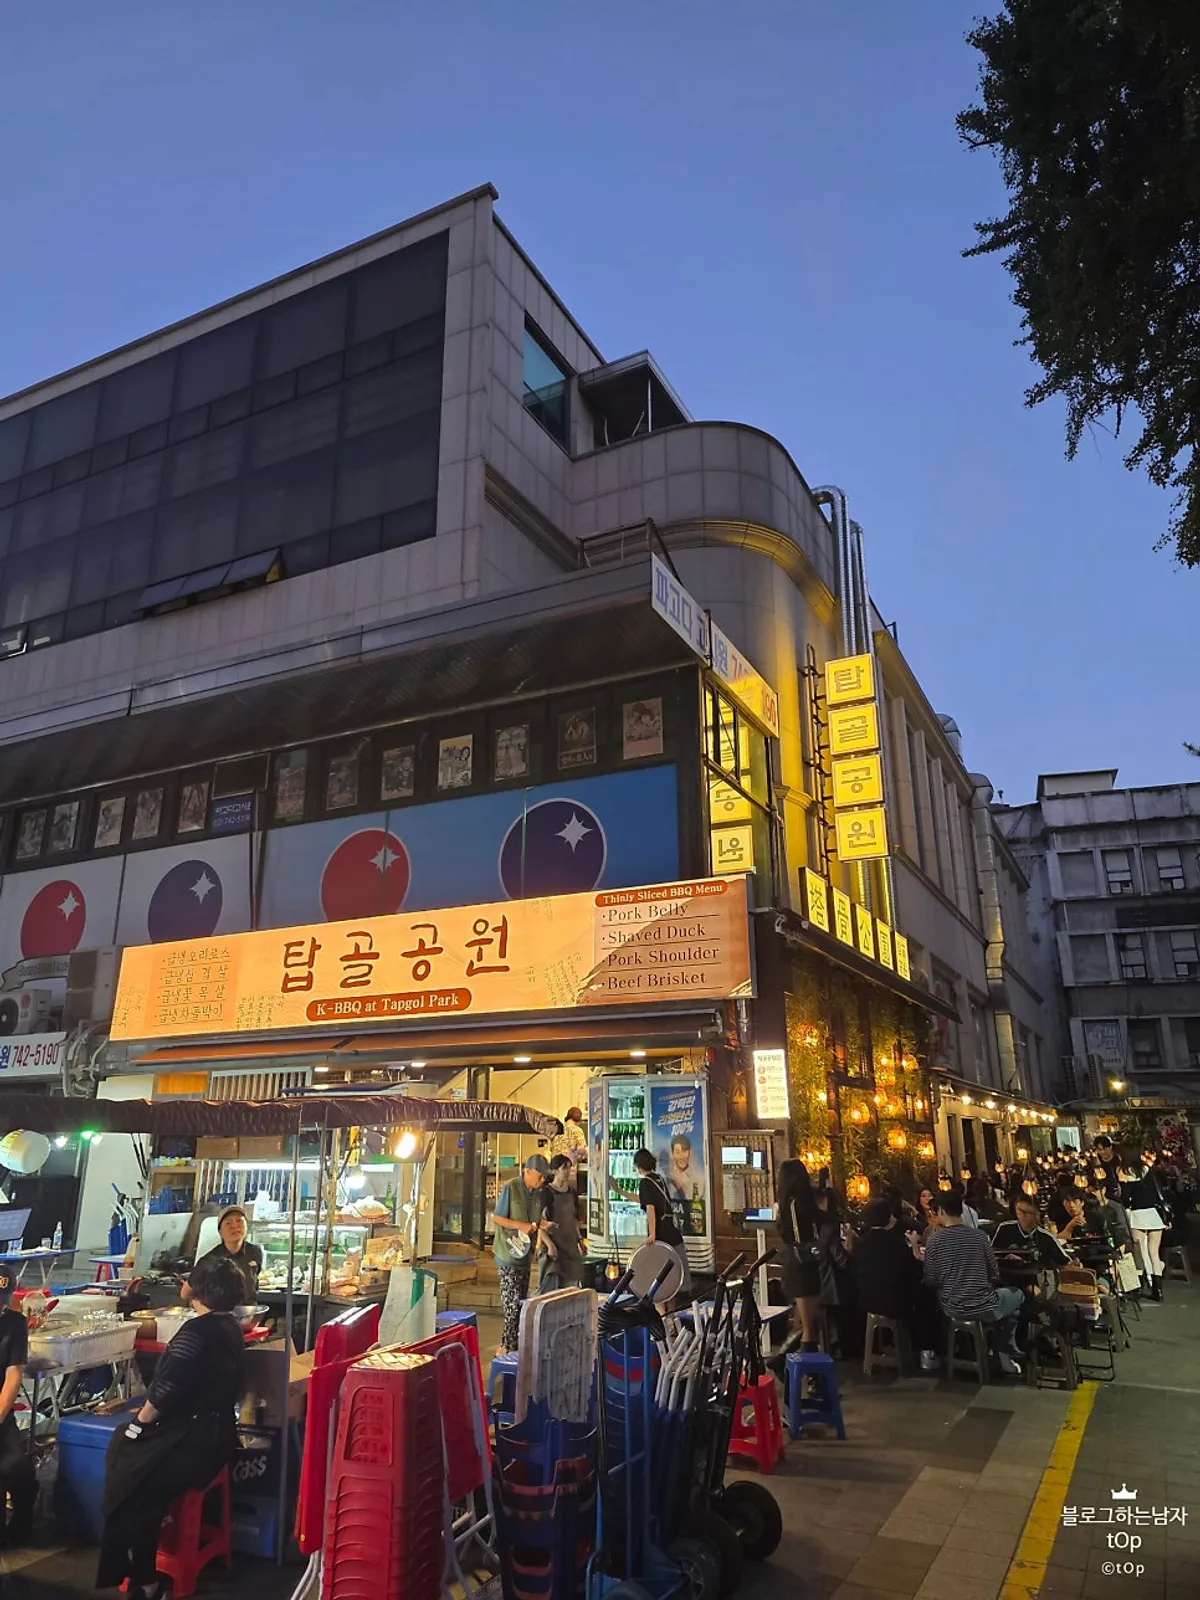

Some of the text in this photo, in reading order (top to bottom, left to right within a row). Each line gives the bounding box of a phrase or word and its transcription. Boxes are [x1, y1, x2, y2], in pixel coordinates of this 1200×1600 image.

[656, 567, 693, 640] 파고다
[834, 664, 878, 849] 탑골공원
[603, 884, 723, 905] Thinly Sliced BBQ Menu
[608, 903, 688, 921] Pork Belly
[608, 923, 706, 944] Shaved Duck
[281, 914, 510, 994] 탑골공원
[608, 947, 719, 967] Pork Shoulder
[608, 972, 707, 990] Beef Brisket
[316, 993, 459, 1016] K-BBQ at Tapgol Park
[12, 1043, 59, 1068] 742-5190
